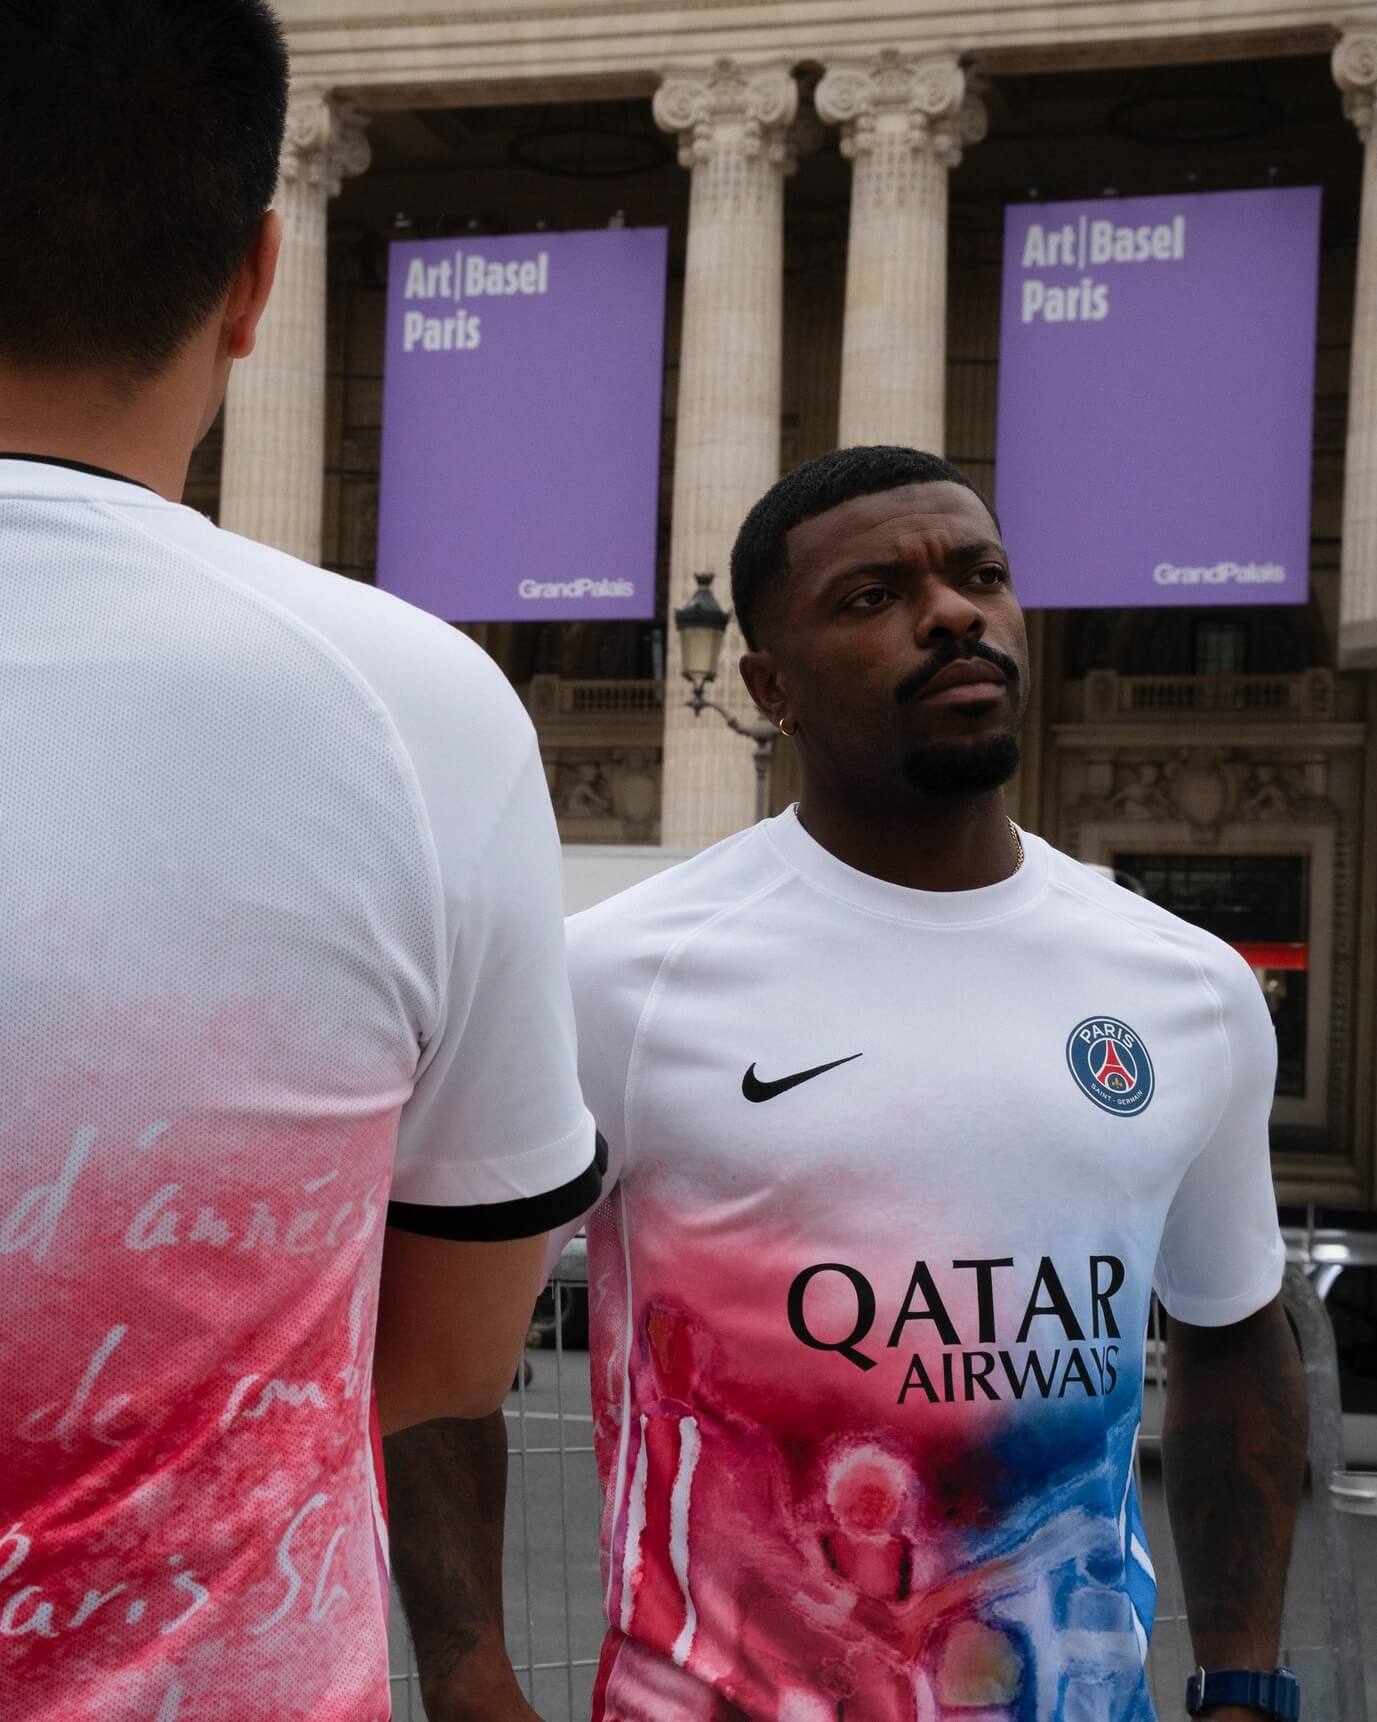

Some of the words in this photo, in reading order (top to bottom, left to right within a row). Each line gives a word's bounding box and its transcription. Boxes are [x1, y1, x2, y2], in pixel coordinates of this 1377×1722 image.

[1022, 278, 1109, 324] Paris
[403, 310, 482, 352] Paris
[1079, 1023, 1135, 1049] PARIS
[787, 1255, 1126, 1373] QATAR
[896, 1345, 1120, 1405] AIRWAYS
